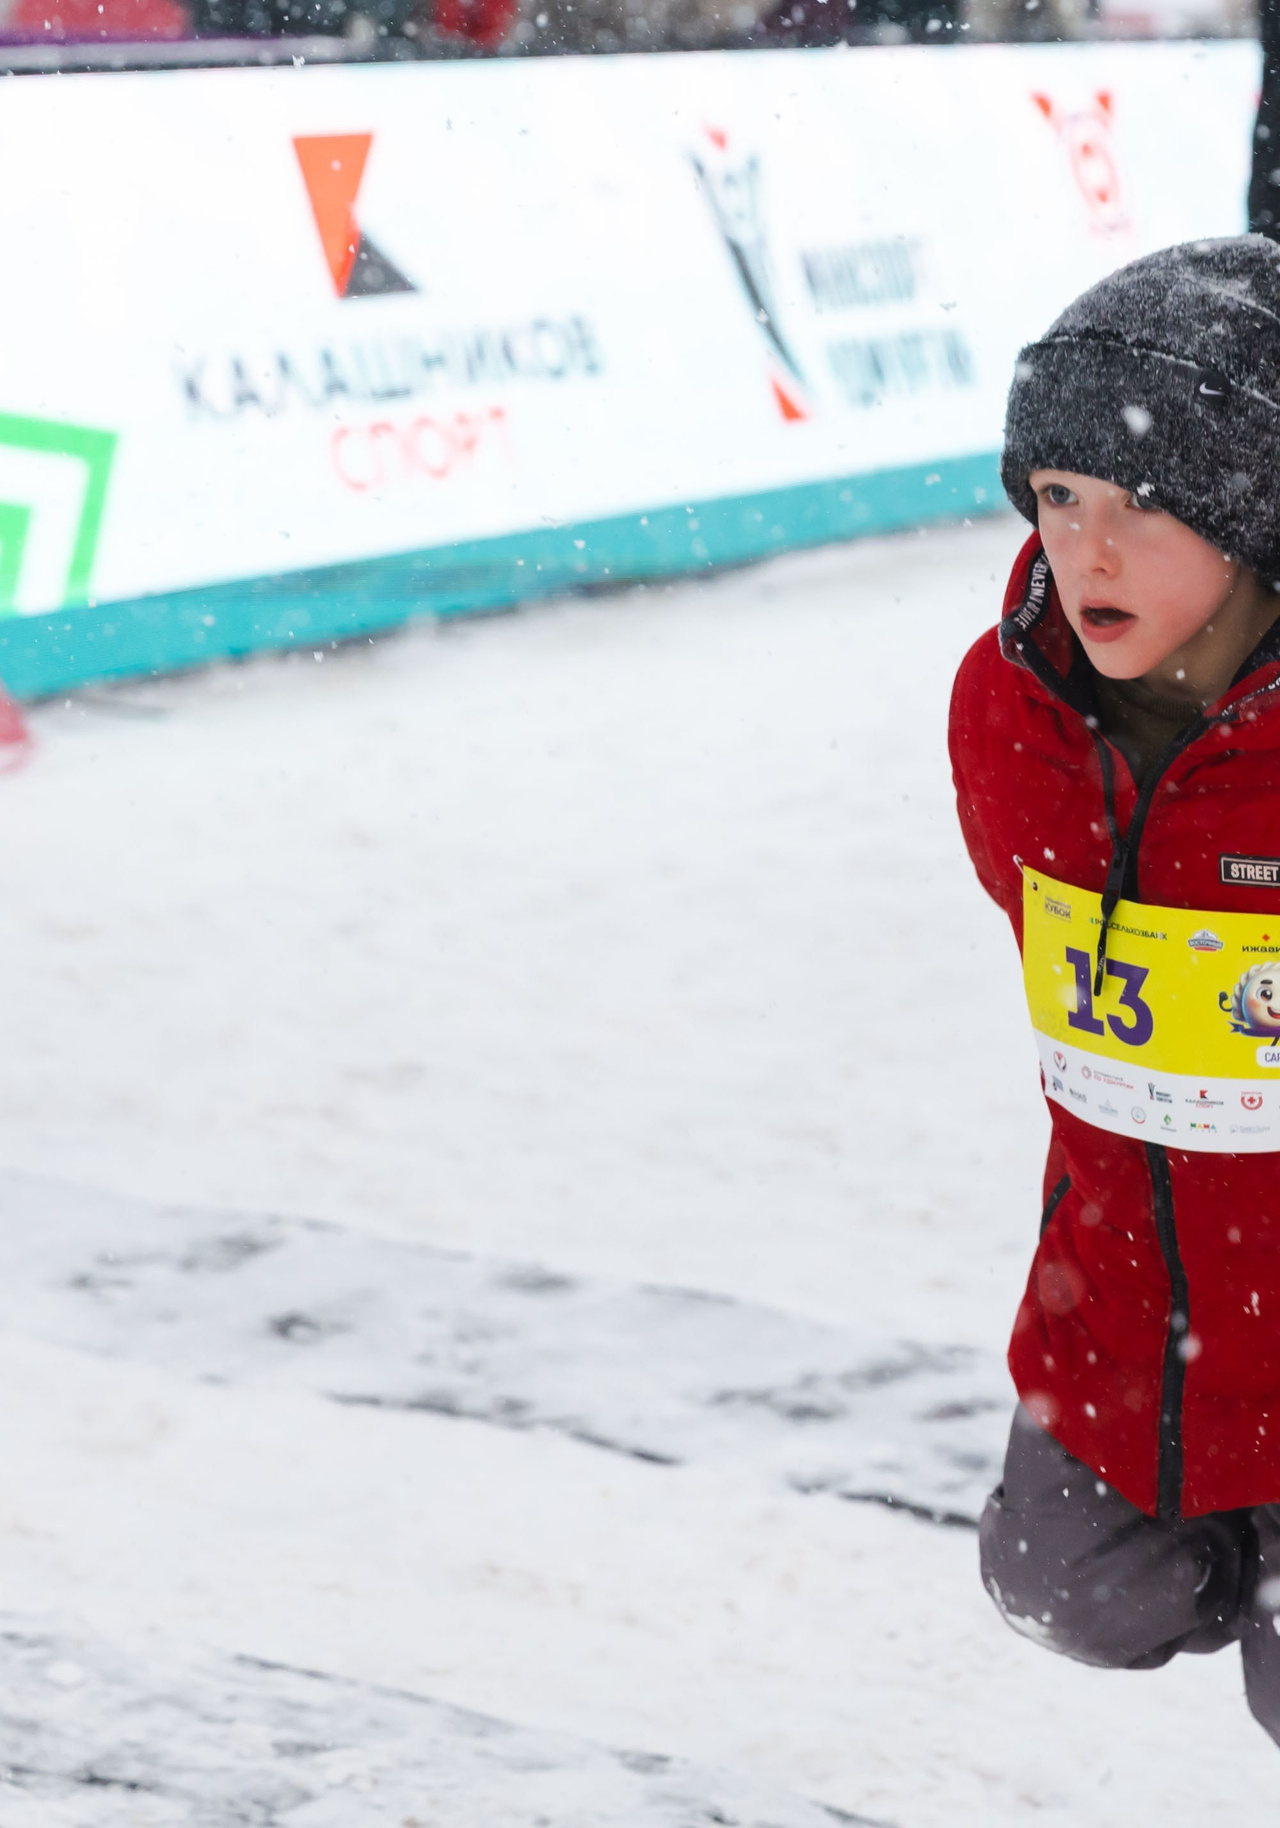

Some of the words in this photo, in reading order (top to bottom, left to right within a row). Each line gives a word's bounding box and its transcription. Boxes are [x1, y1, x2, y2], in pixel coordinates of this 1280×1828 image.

[174, 314, 606, 422] КАЛАШНИКОВ
[328, 404, 518, 492] СПОРТ
[1045, 902, 1071, 919] КУБОК
[1230, 862, 1279, 881] STREET
[1065, 945, 1153, 1046] 13
